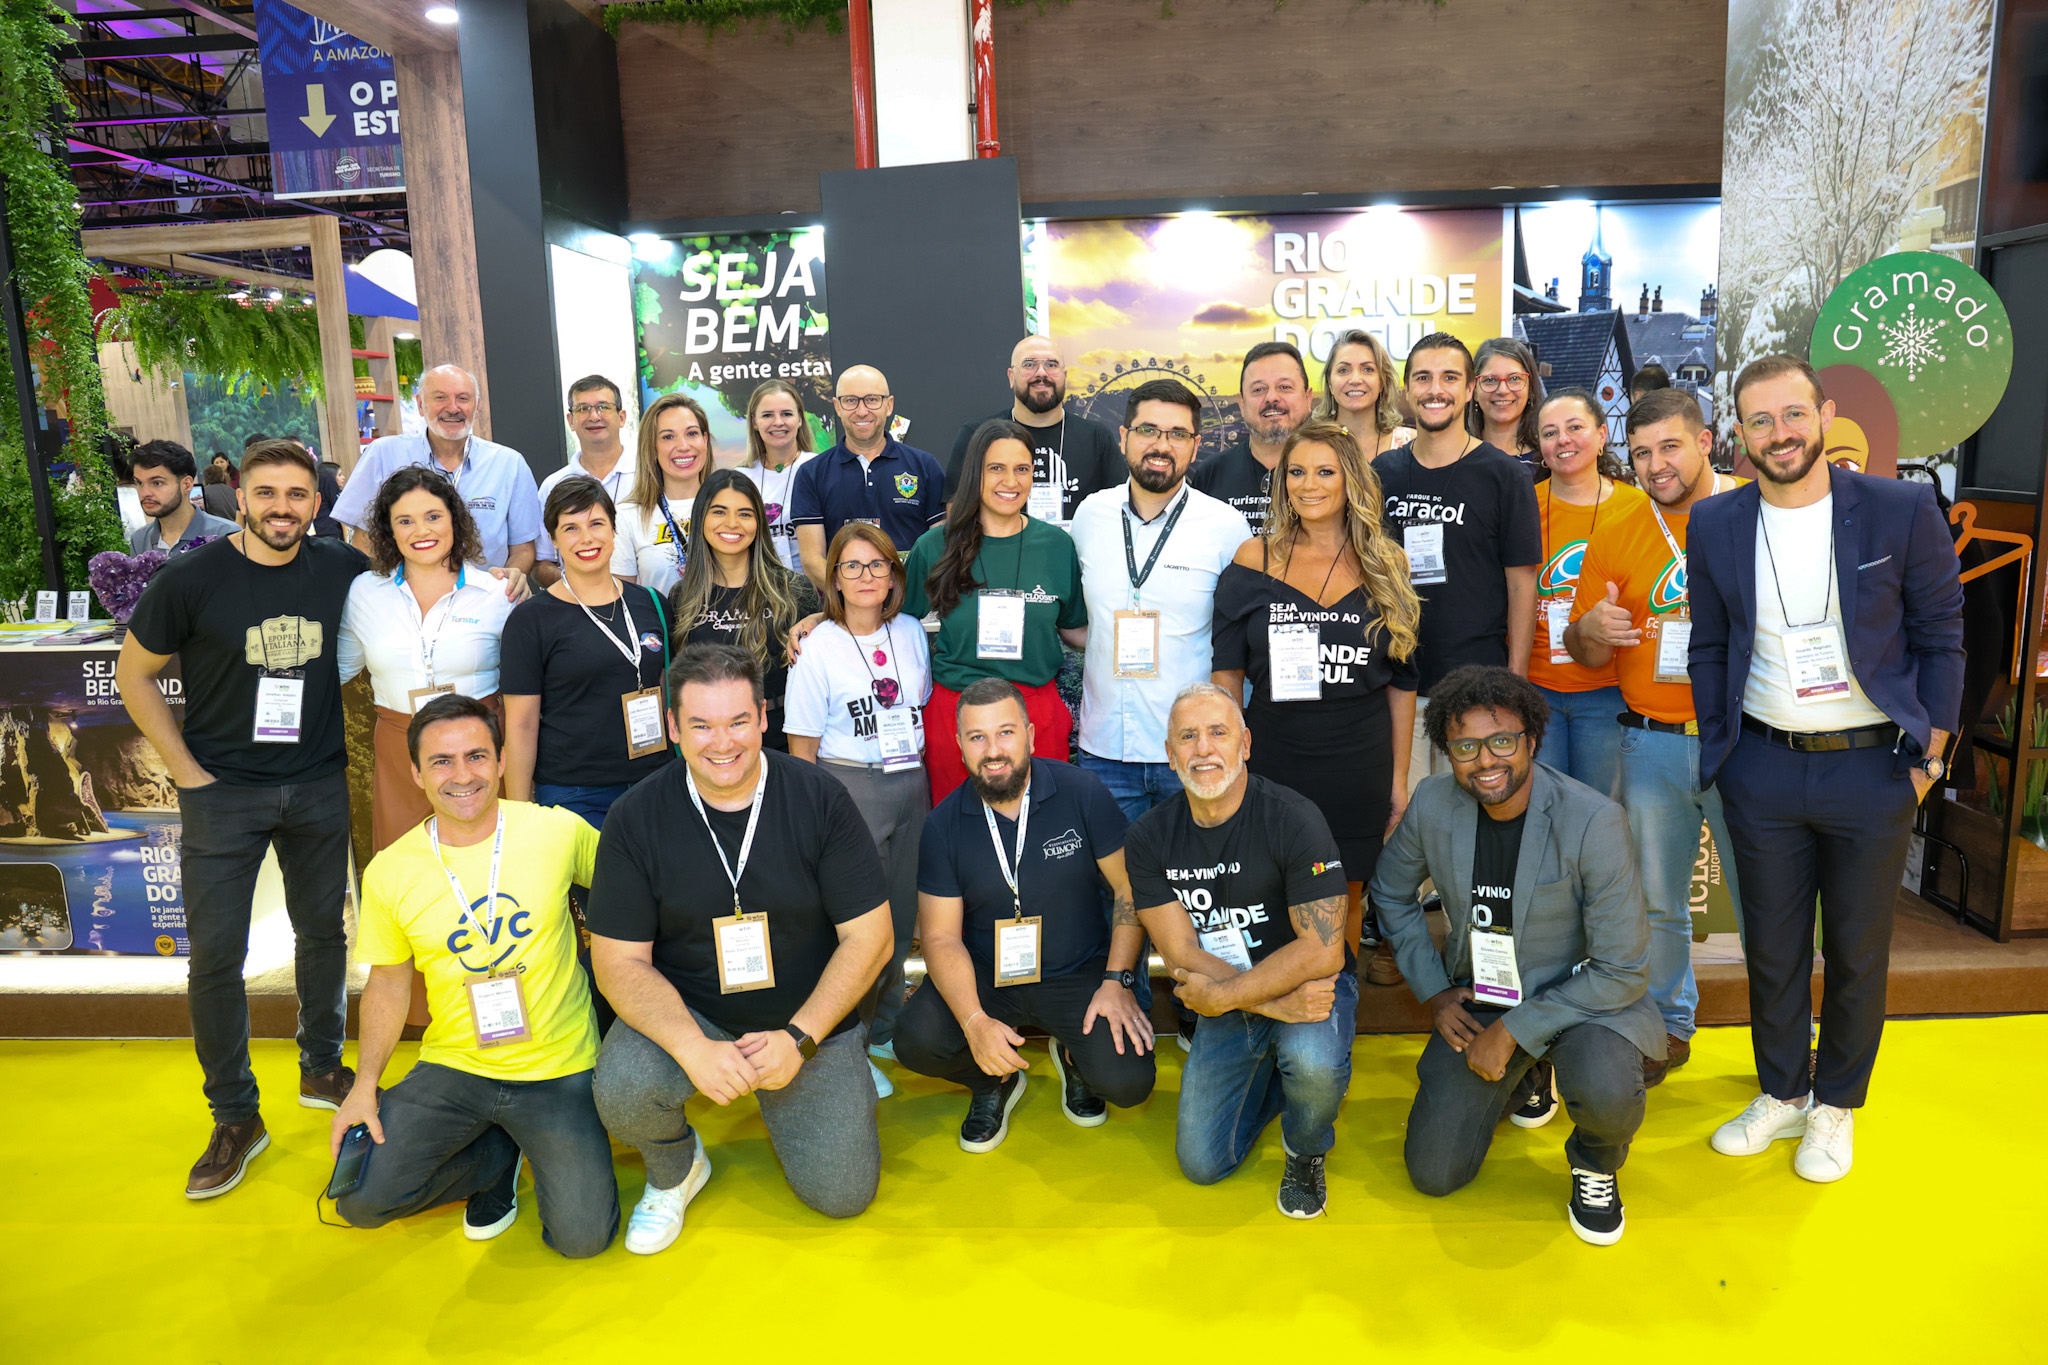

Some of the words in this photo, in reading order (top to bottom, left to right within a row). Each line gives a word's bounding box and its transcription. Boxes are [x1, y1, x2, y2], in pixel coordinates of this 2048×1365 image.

[313, 49, 323, 62] A
[350, 81, 374, 106] O
[1274, 231, 1350, 273] RIO
[680, 250, 816, 302] SEJA
[1273, 273, 1477, 318] GRANDE
[1833, 271, 1988, 351] Gramado
[685, 304, 826, 355] BEM-
[688, 362, 704, 381] A
[709, 360, 772, 384] gente
[1385, 496, 1465, 525] Caracol
[1269, 603, 1298, 612] SEJA
[1269, 612, 1339, 623] BEM-VINDO
[1342, 613, 1360, 624] AO
[265, 641, 306, 651] ITALIANA
[82, 661, 116, 678] SEJ
[847, 695, 873, 718] EU
[140, 847, 176, 864] RIO
[1043, 840, 1082, 860] JOLIMONT
[146, 885, 177, 902] DO
[158, 914, 181, 922] gente
[447, 911, 533, 955] CVC
